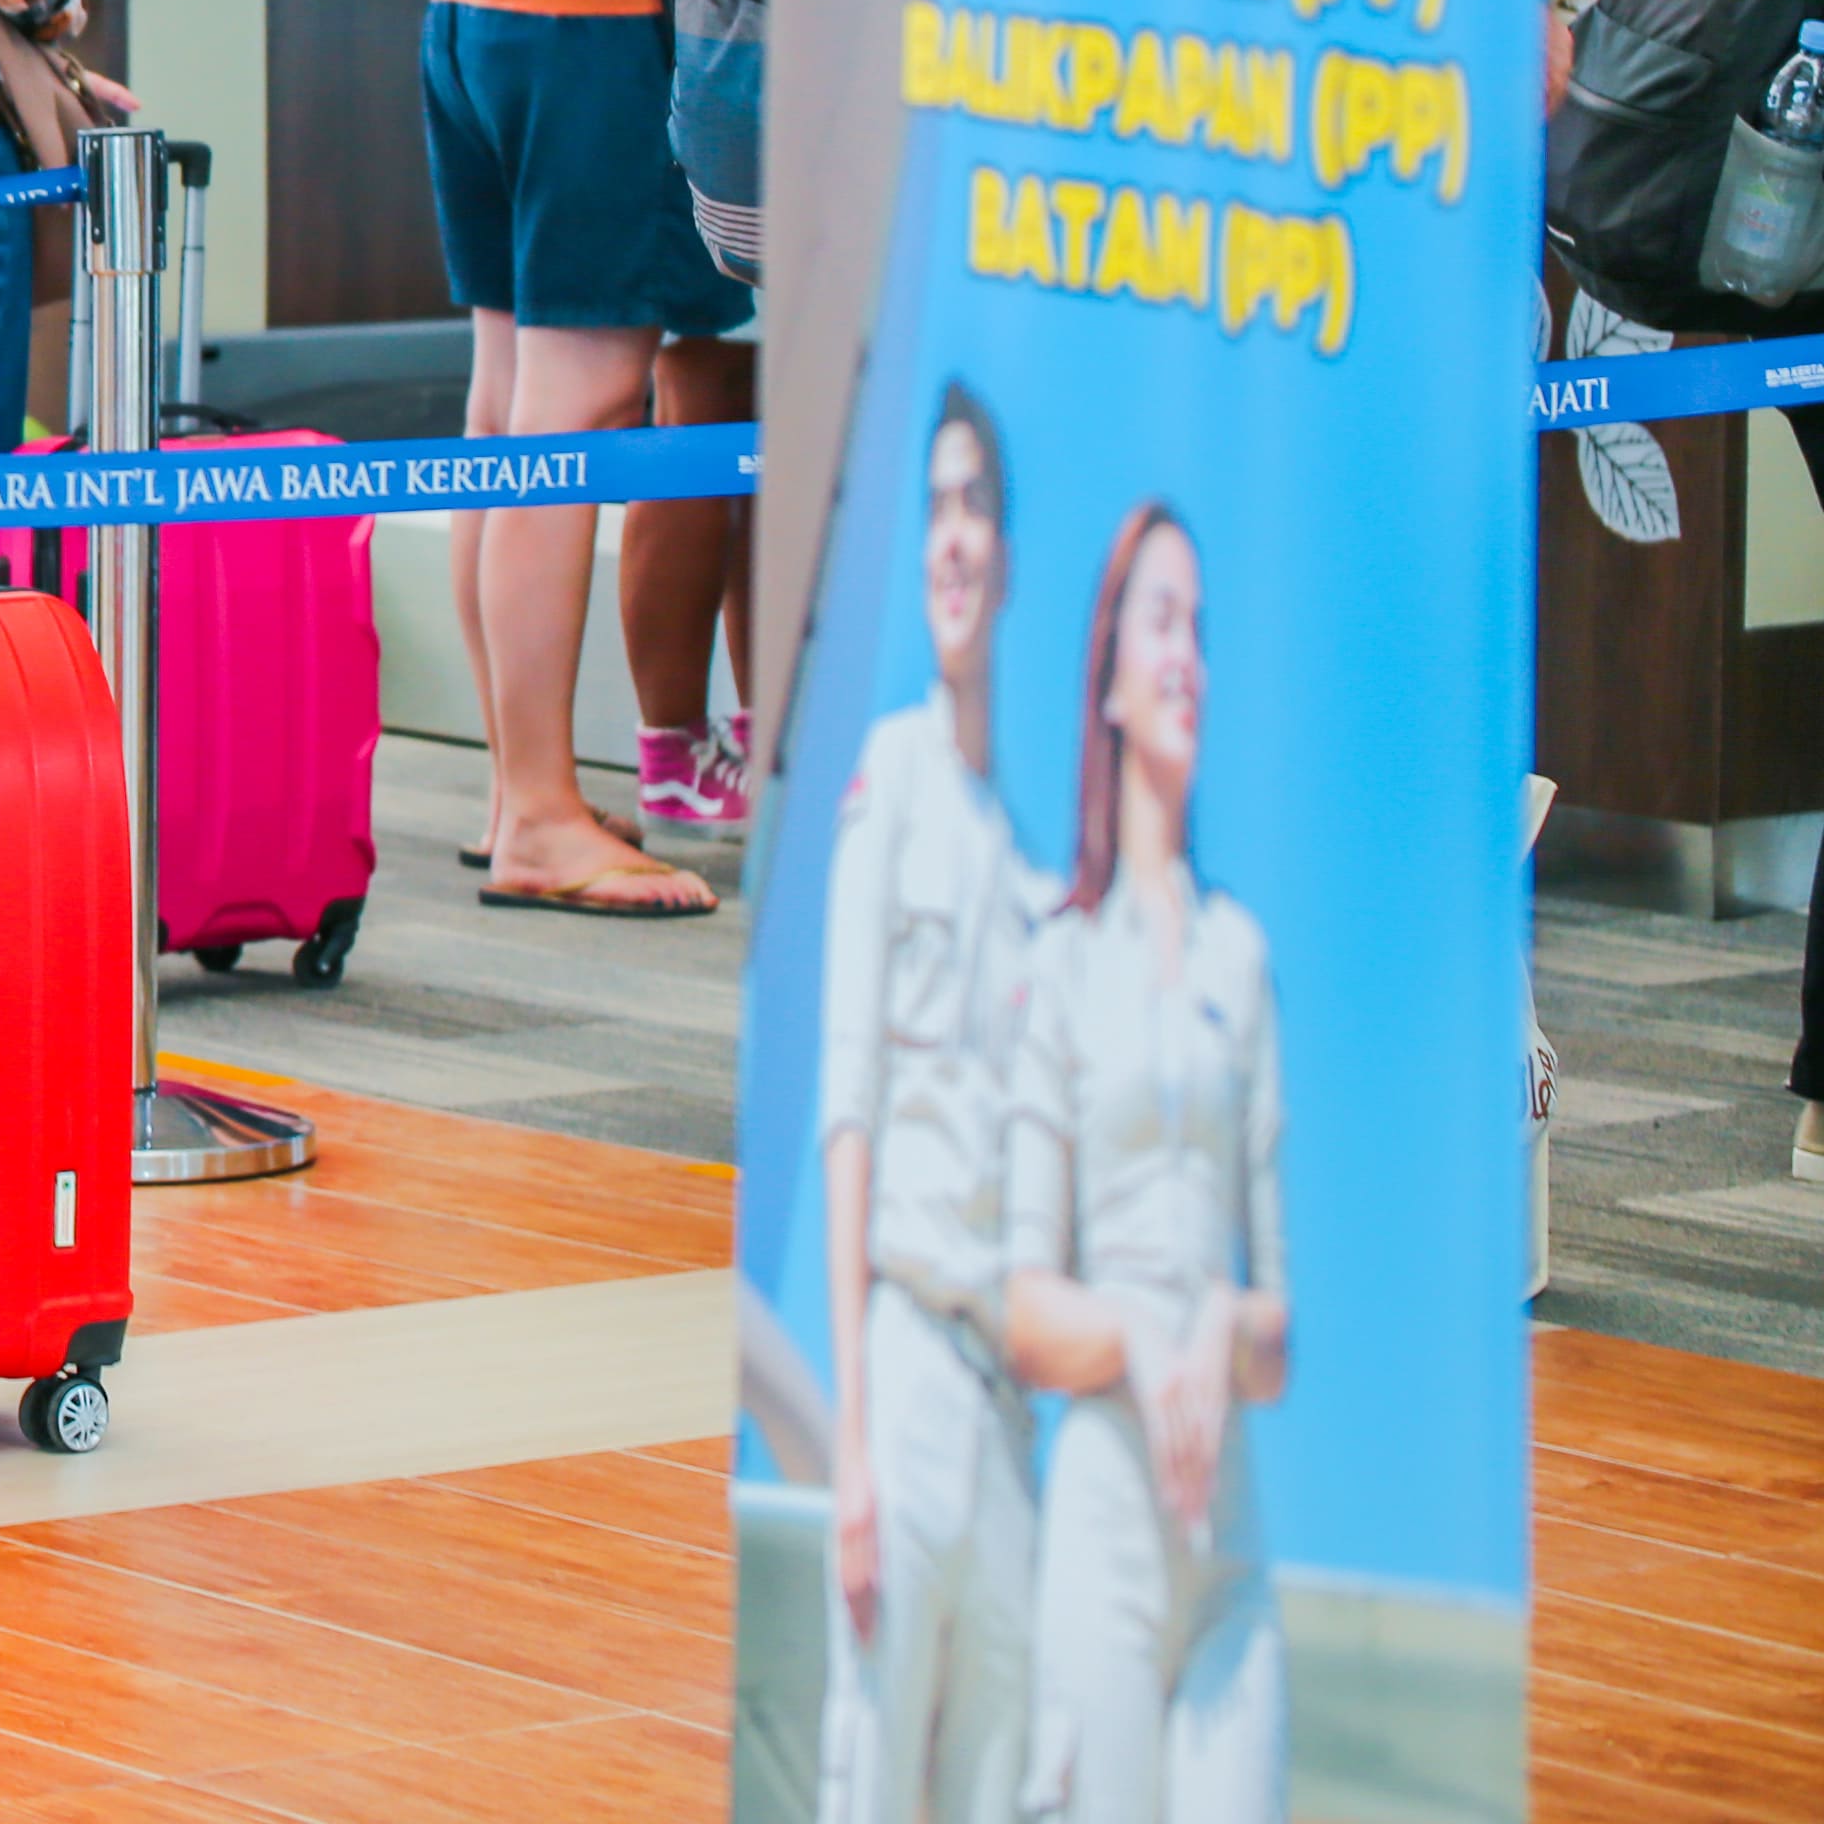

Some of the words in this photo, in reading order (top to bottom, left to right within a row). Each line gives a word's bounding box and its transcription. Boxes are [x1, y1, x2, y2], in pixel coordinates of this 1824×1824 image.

[1312, 49, 1468, 205] (PP)
[1221, 199, 1353, 354] (PP)
[64, 467, 165, 509] INT'L
[174, 465, 273, 514] JAWA
[281, 460, 397, 501] BARAT
[406, 451, 589, 499] KERTAJATI
